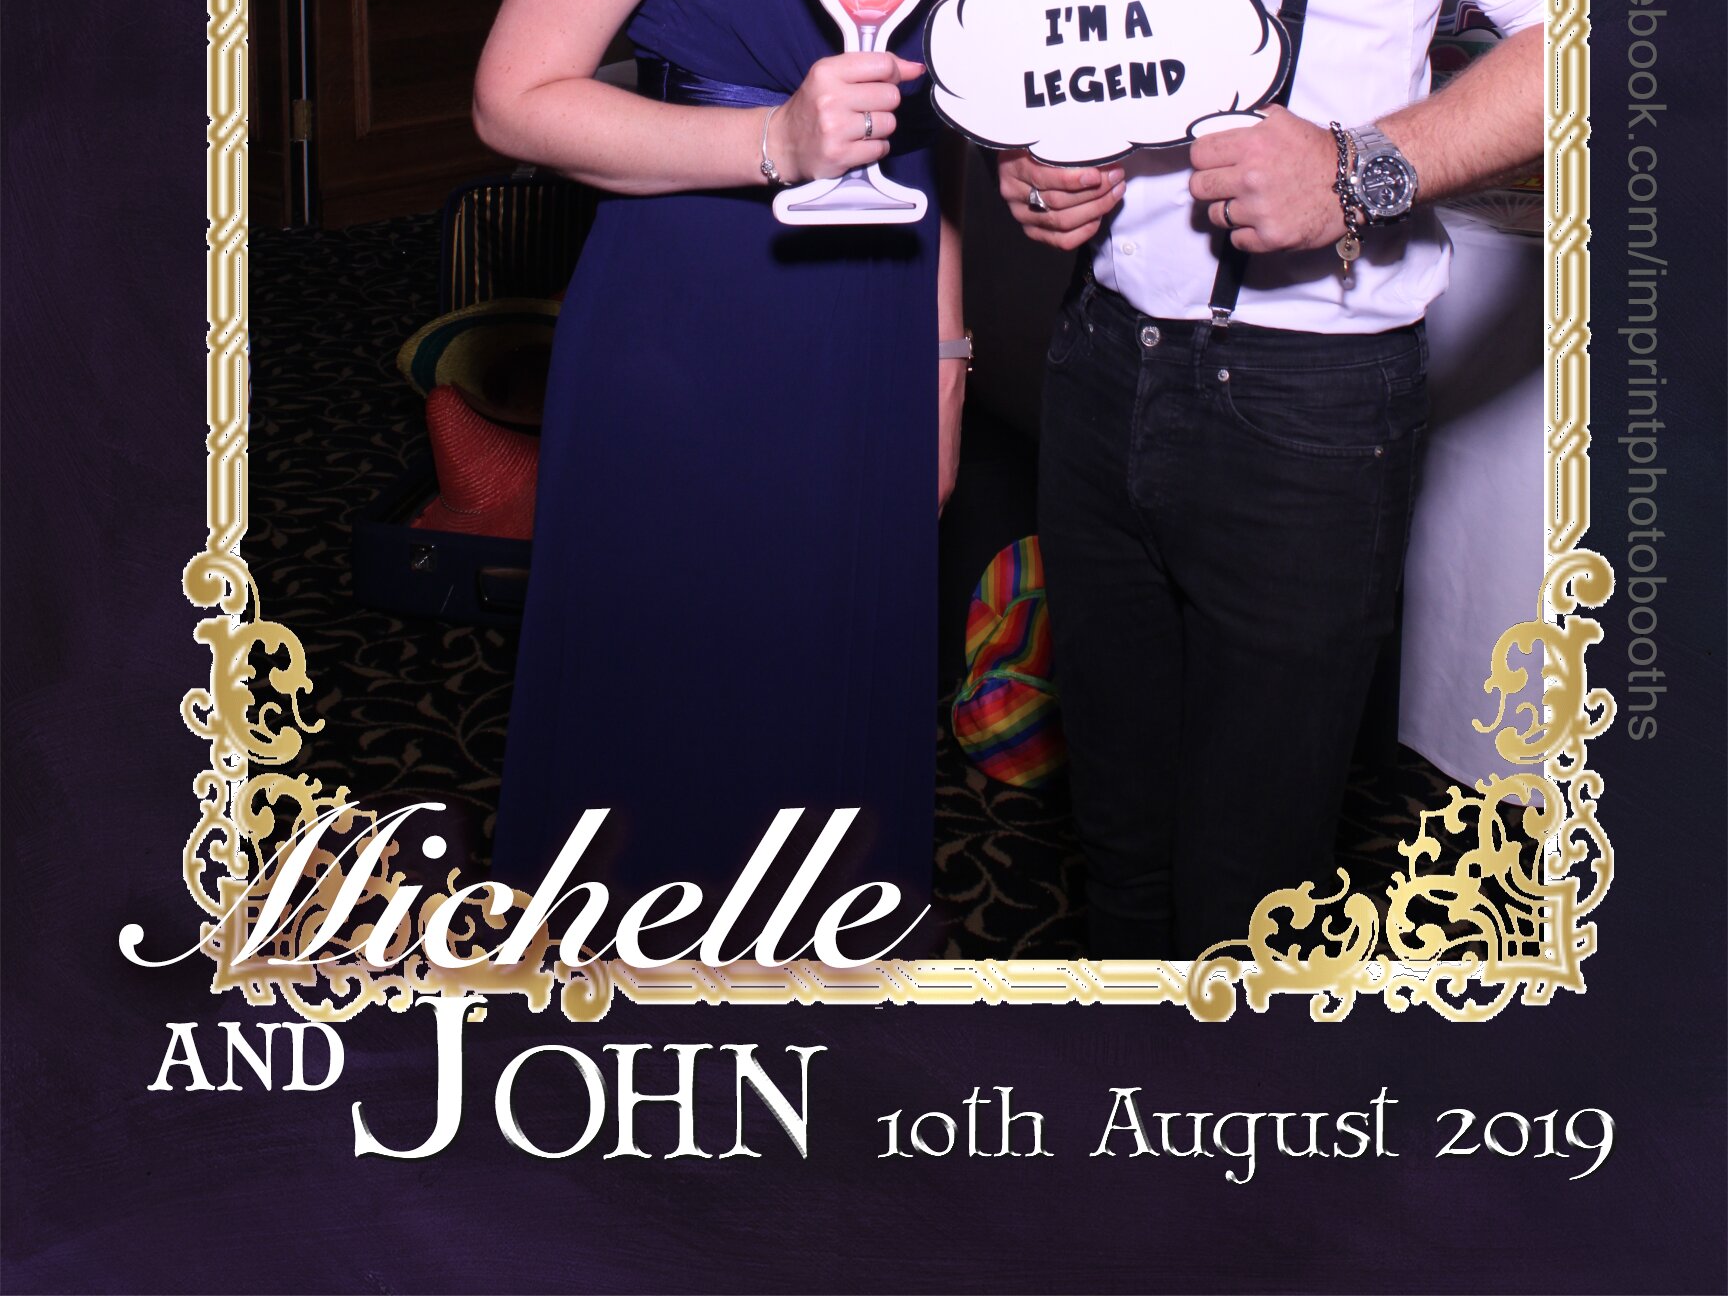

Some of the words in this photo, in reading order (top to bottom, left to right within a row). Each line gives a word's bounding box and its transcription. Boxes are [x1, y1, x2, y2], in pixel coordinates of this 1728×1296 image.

[1045, 5, 1107, 46] I'M
[1125, 1, 1153, 39] A
[1024, 59, 1186, 108] LEGEND
